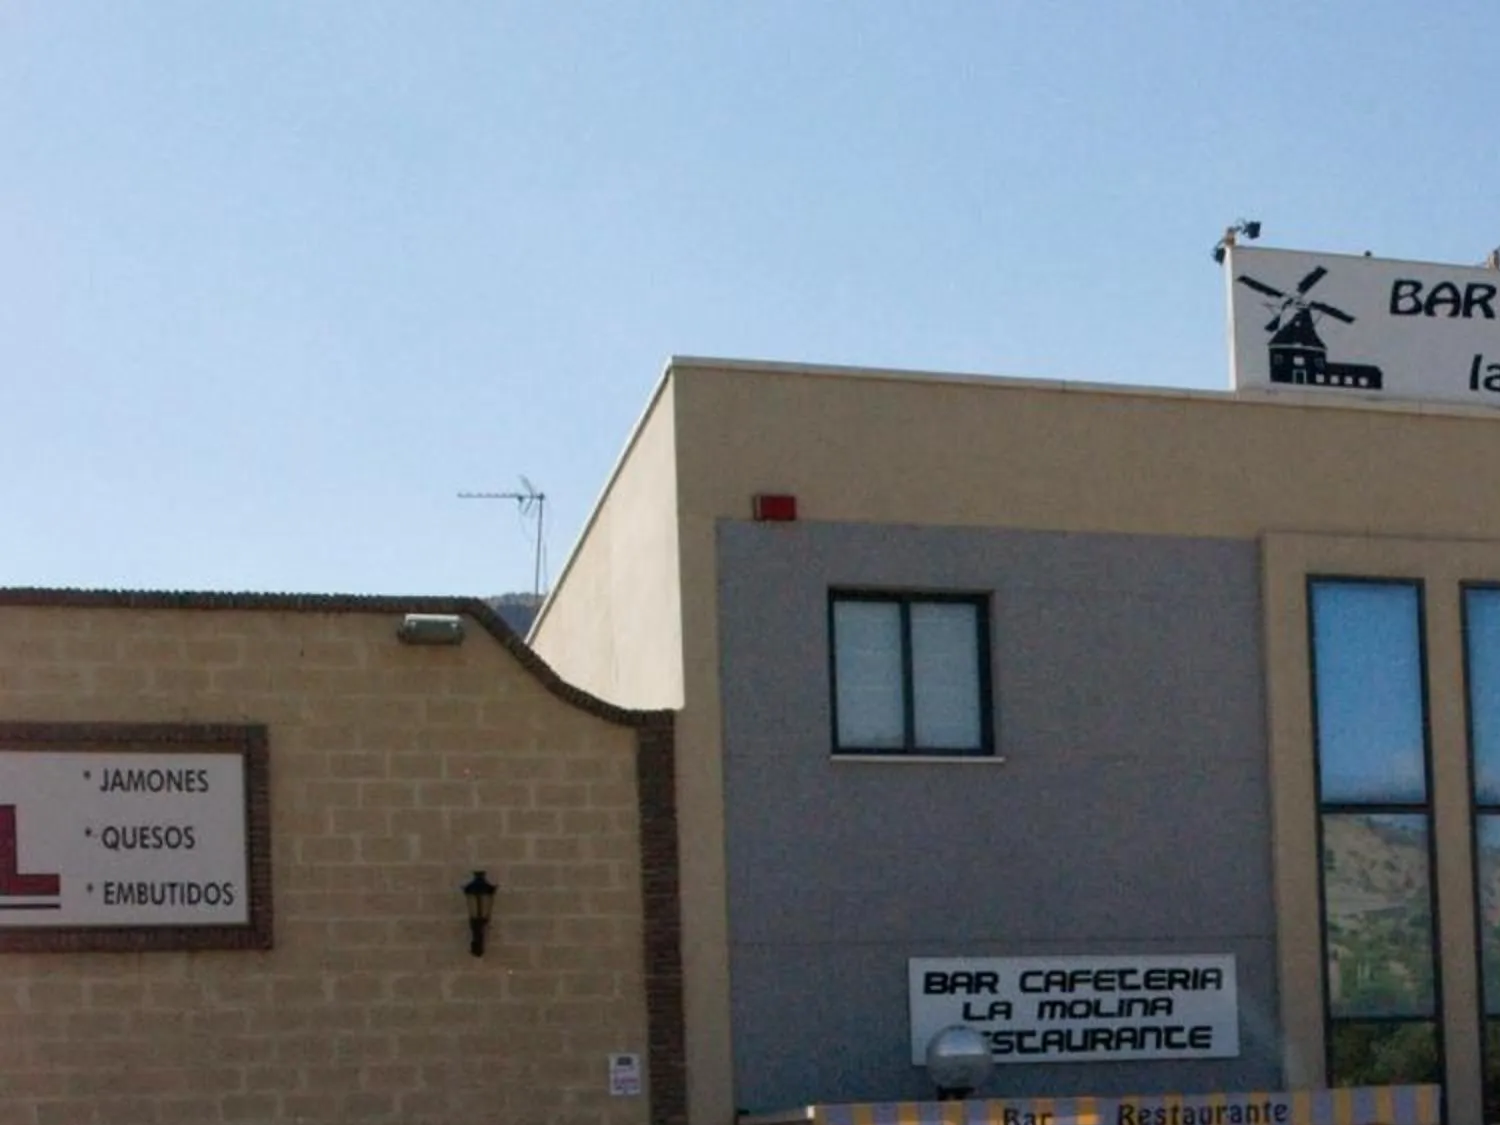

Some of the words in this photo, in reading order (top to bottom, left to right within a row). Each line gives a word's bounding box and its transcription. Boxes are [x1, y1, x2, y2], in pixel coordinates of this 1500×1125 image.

[1389, 278, 1498, 320] BAR
[98, 768, 210, 793] JAMONES
[101, 825, 197, 851] QUESOS
[102, 881, 235, 906] EMBUTIDOS
[923, 970, 1000, 995] BAR
[1018, 967, 1224, 993] CAFETERIA
[961, 1001, 1013, 1022] LA
[1036, 996, 1175, 1020] MOLINA
[979, 1024, 1214, 1054] STAURANTE
